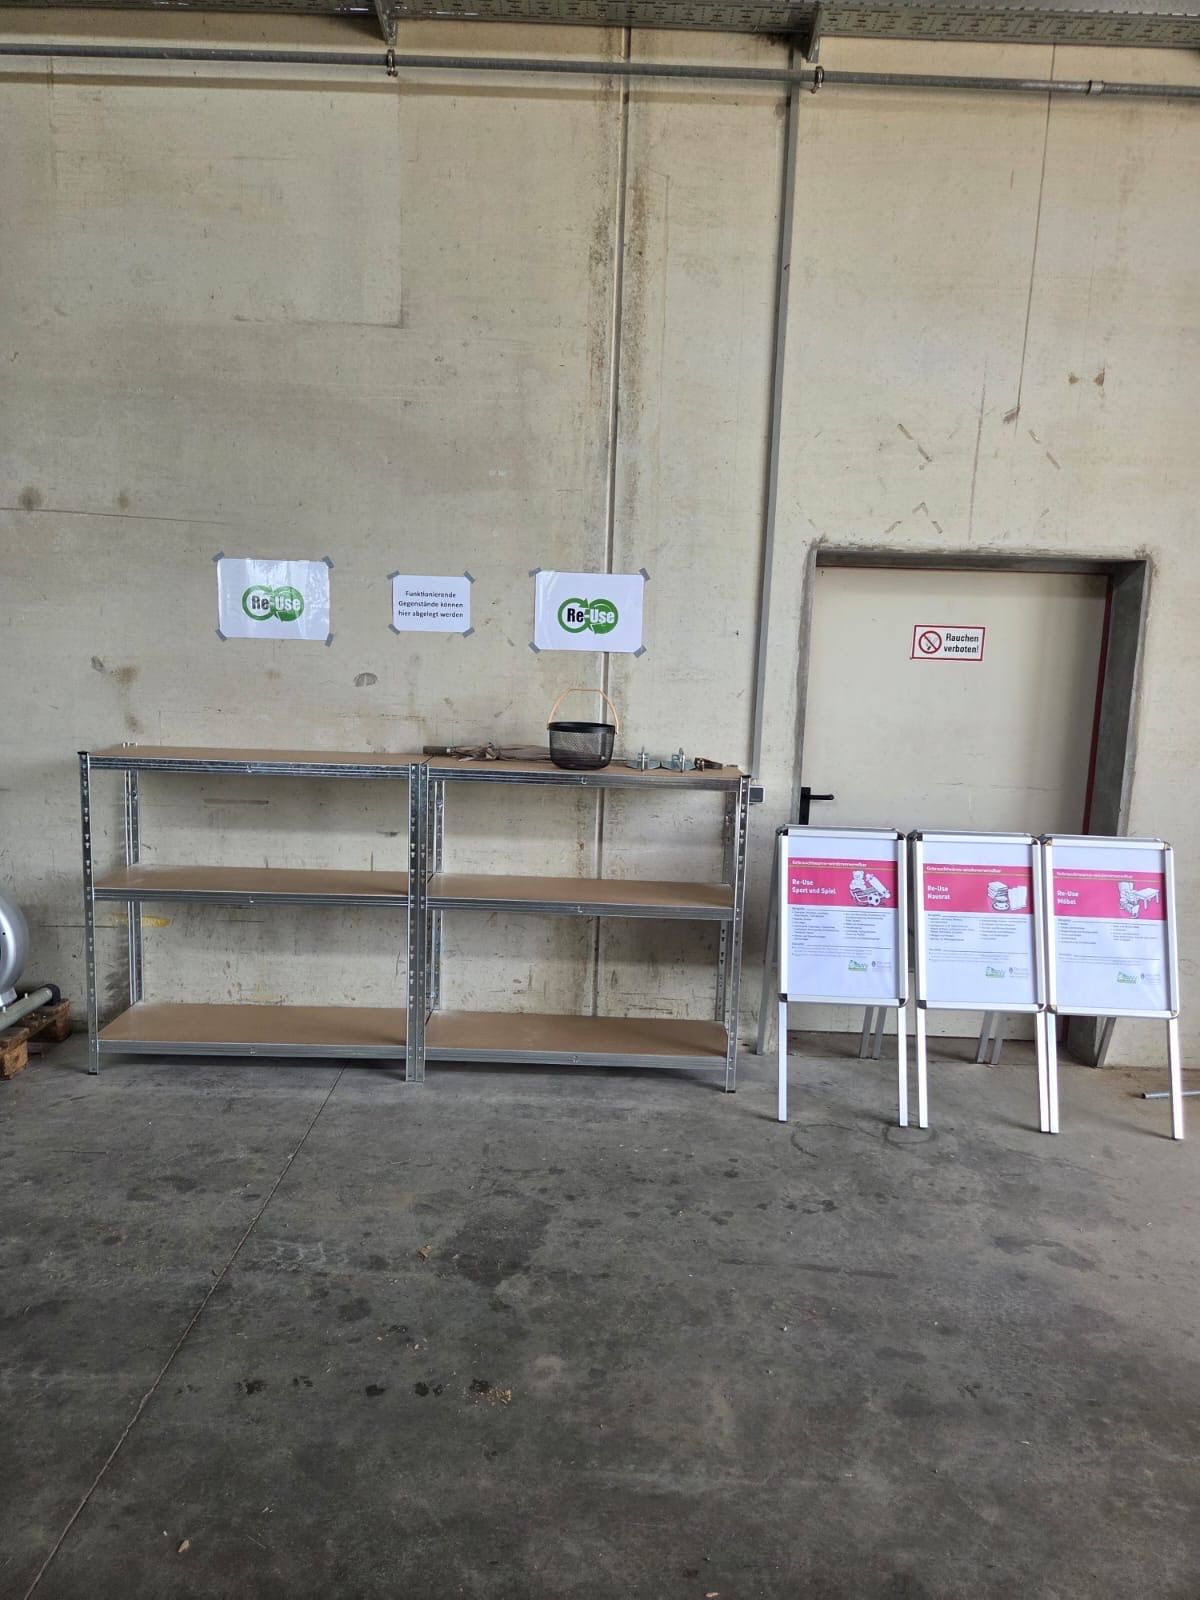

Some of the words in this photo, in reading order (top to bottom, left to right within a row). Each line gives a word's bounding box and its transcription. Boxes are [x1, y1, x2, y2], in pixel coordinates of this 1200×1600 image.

[398, 600, 439, 608] Gegenstände
[412, 610, 439, 618] abgelegt
[567, 608, 615, 624] Re-Use
[945, 633, 979, 642] Rauchen
[944, 645, 979, 653] verboten!
